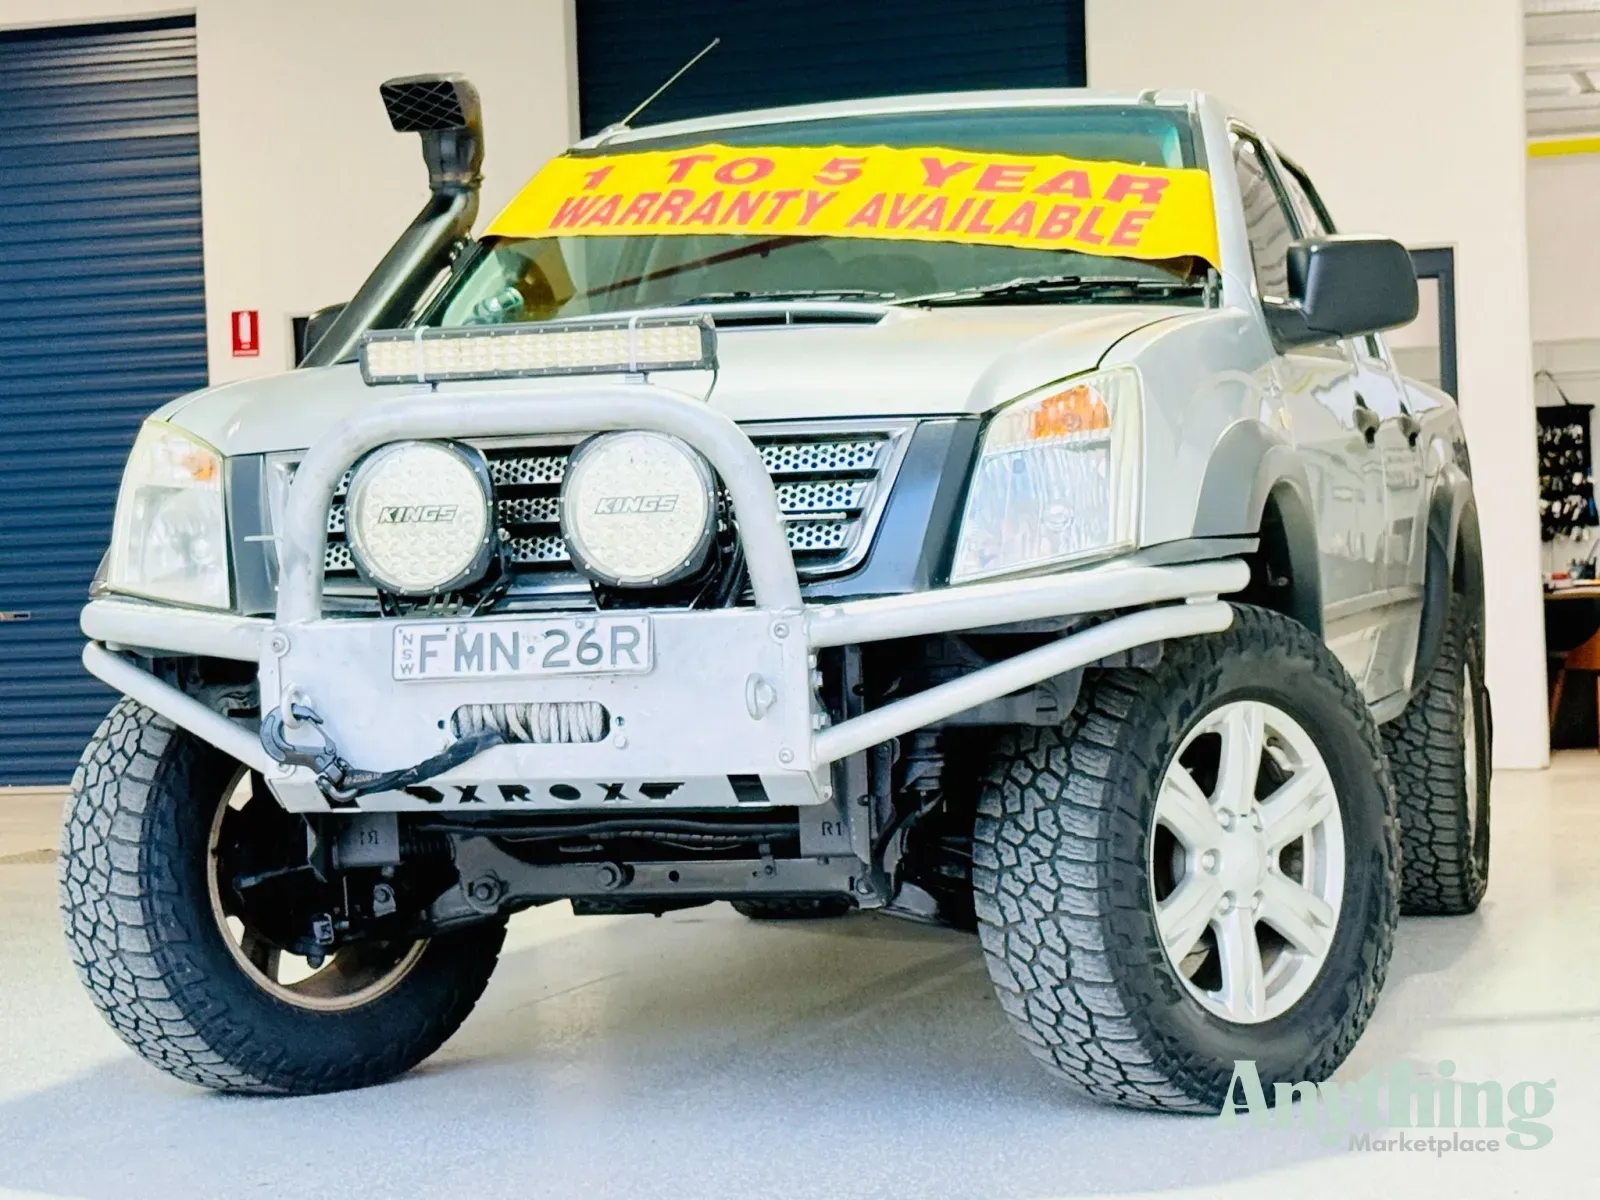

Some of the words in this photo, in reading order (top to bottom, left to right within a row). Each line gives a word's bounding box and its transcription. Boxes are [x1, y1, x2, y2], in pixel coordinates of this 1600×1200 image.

[584, 164, 613, 189] 1
[667, 155, 777, 185] TO
[815, 157, 868, 186] 5
[920, 157, 1170, 204] YEAR
[550, 189, 839, 228] WARRANTY
[845, 192, 1154, 246] AVAILABLE
[378, 505, 458, 523] KINGS
[593, 494, 679, 514] KINGS
